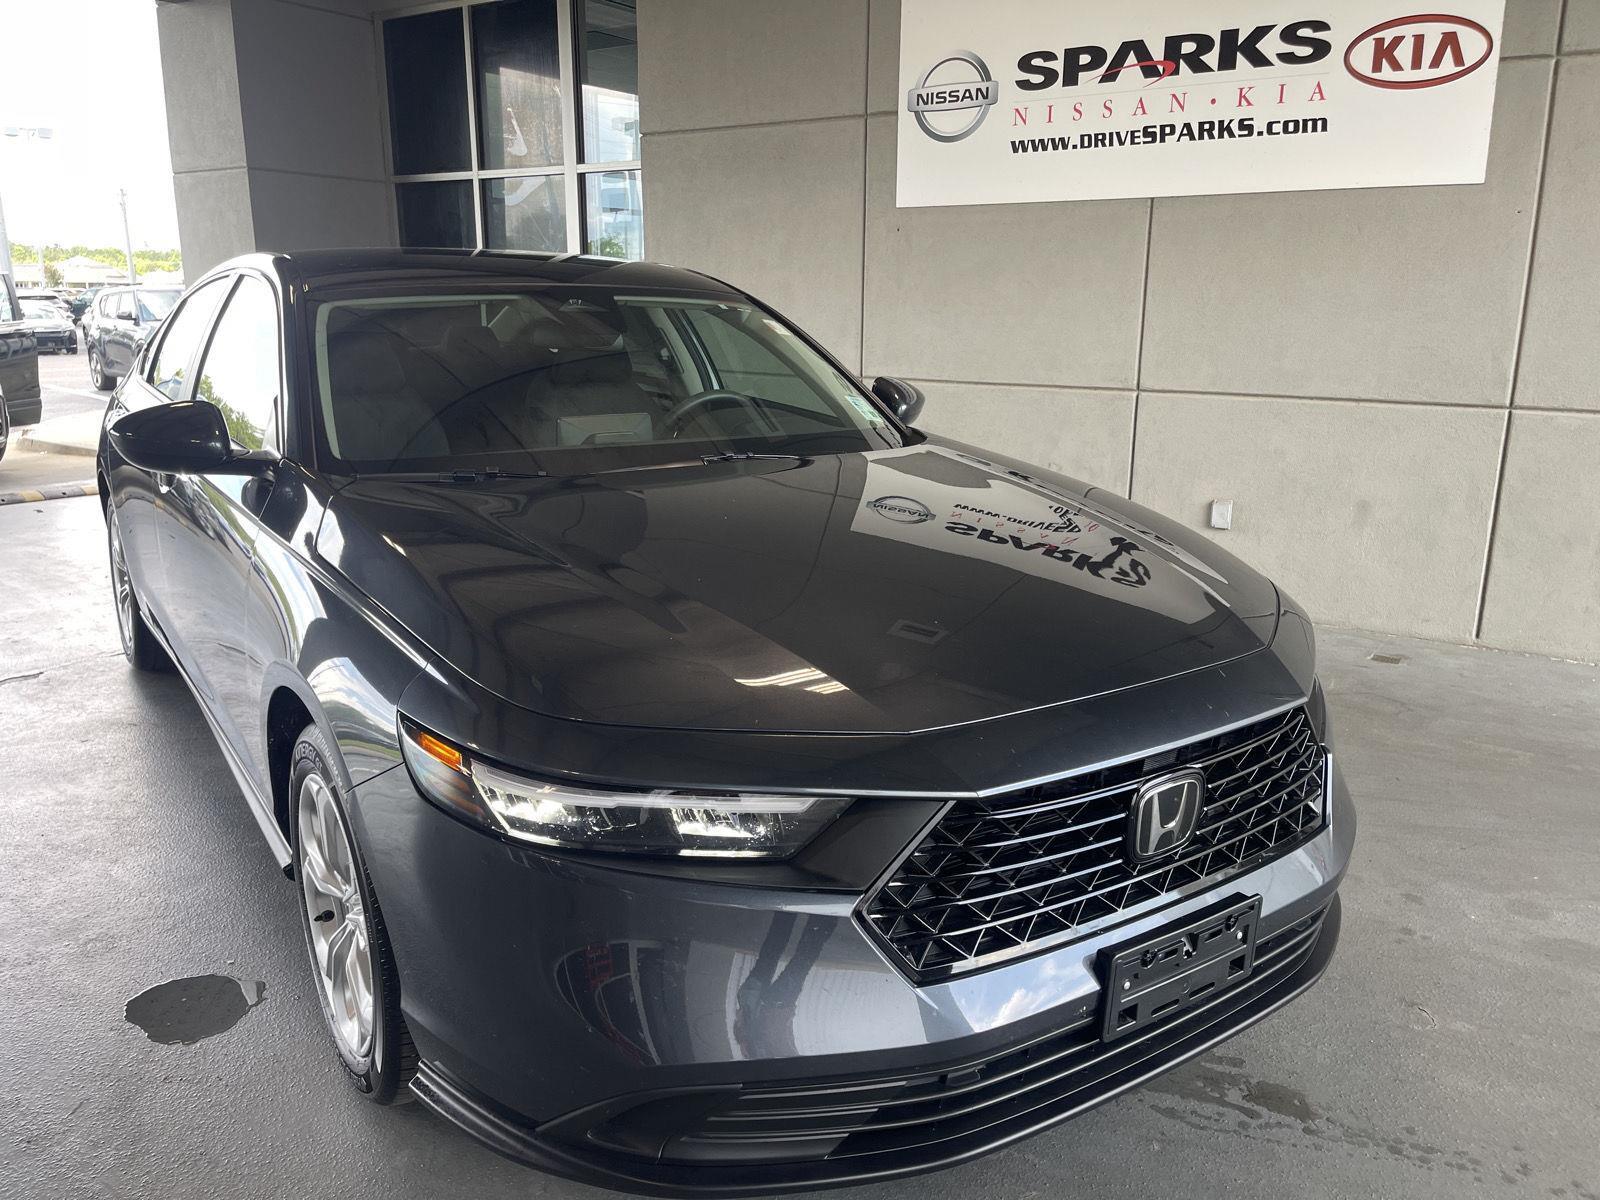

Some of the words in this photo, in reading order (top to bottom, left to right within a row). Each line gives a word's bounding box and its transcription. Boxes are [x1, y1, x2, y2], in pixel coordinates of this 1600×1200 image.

[1015, 19, 1332, 91] SPARKS
[1371, 31, 1466, 74] KIA
[916, 86, 990, 106] NISSAN
[1236, 80, 1327, 108] KIA
[1010, 117, 1328, 154] www.DRIVESPARKS.com
